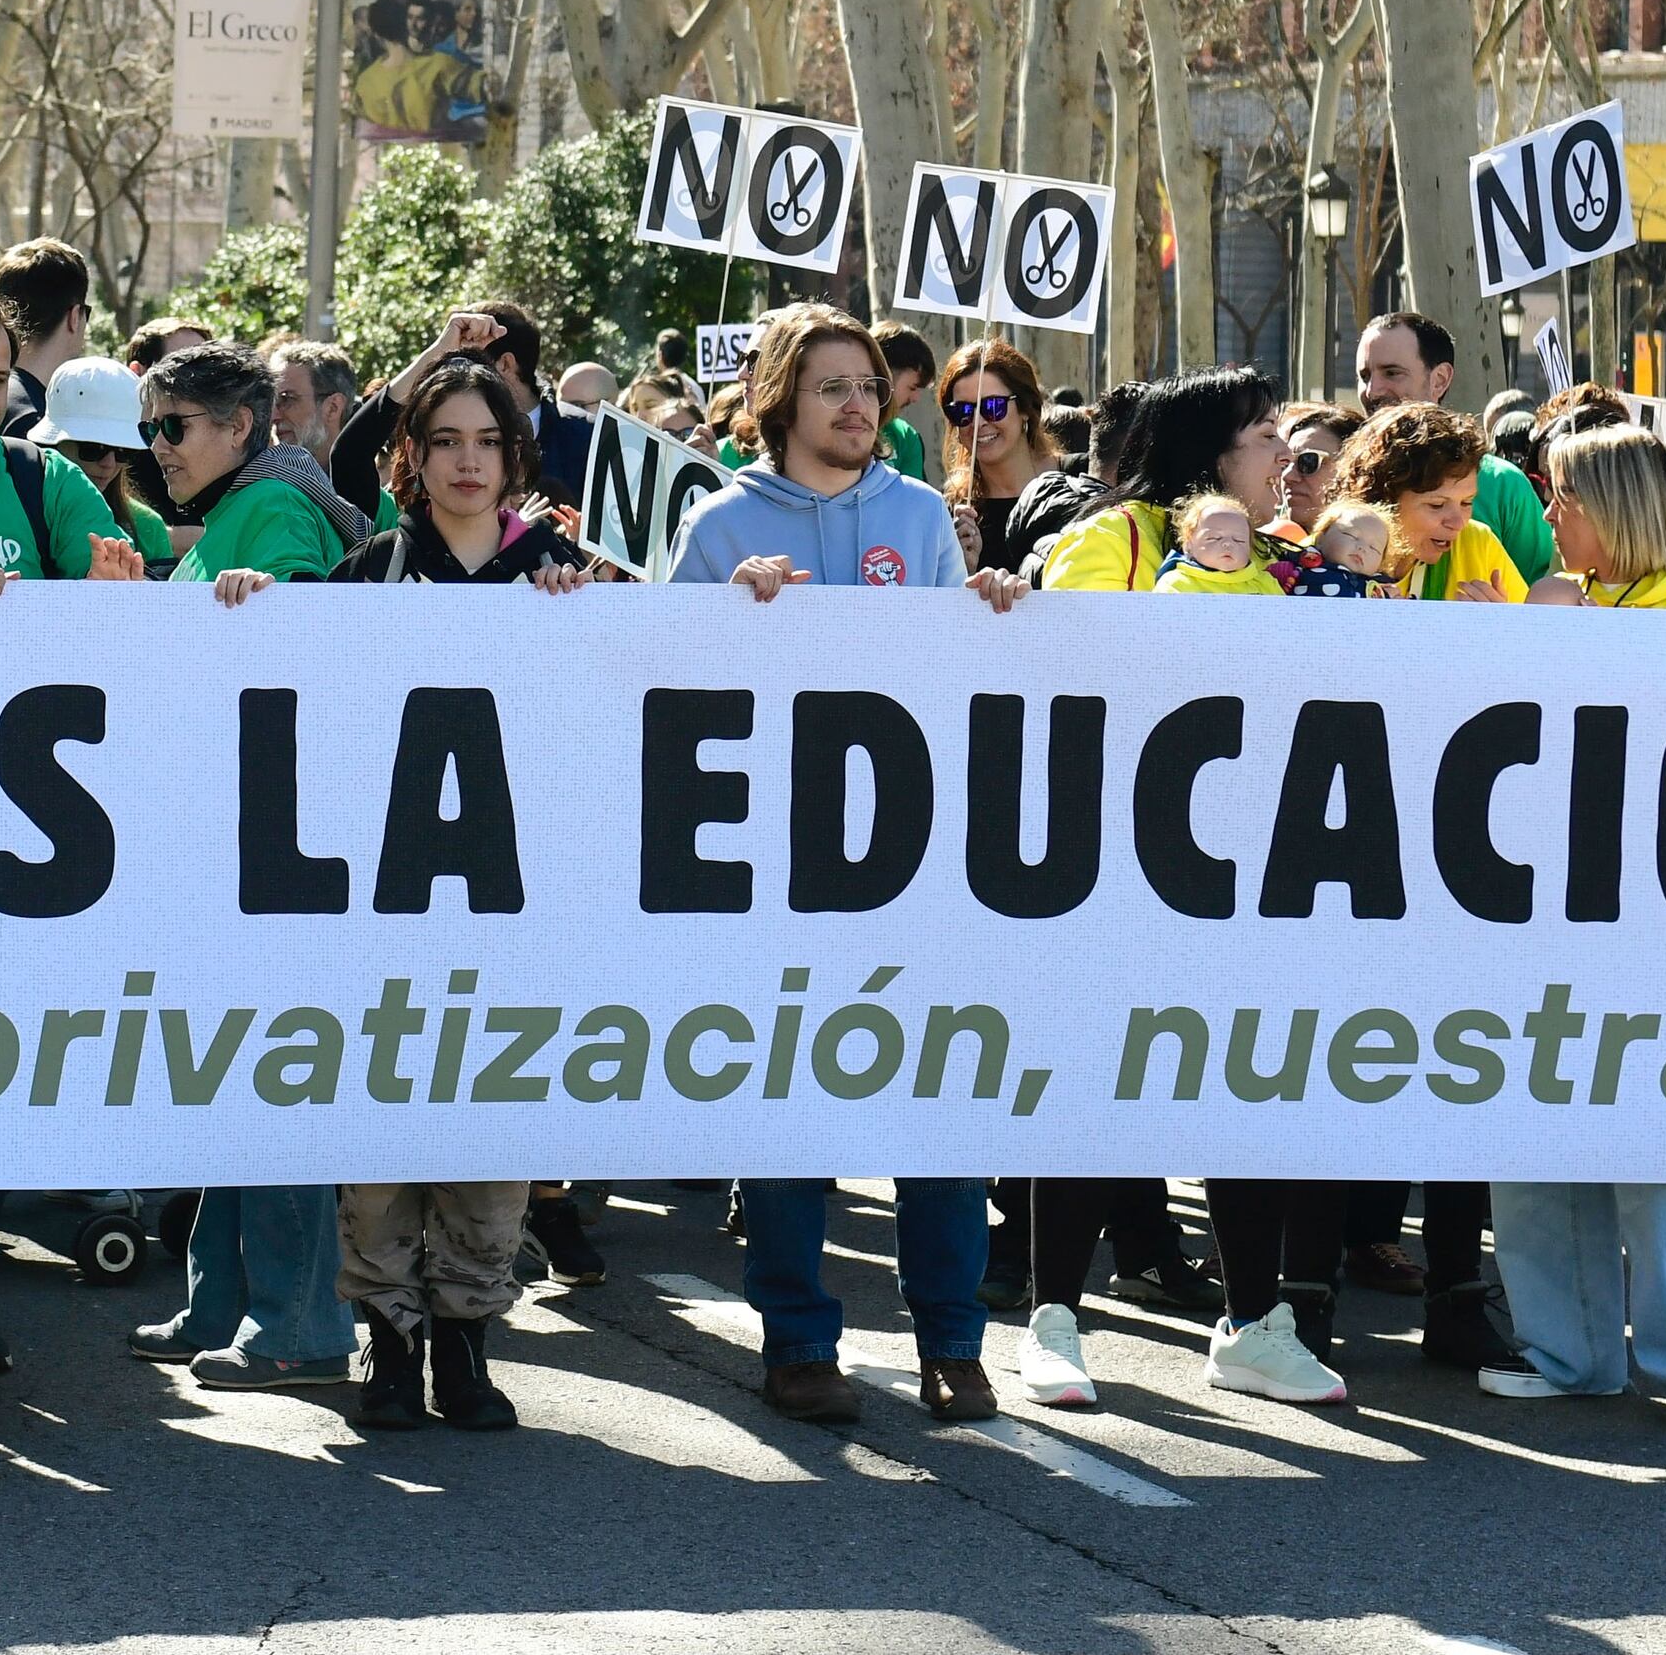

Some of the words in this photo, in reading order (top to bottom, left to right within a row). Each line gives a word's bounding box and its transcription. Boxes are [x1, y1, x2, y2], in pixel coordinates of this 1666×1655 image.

[188, 10, 212, 39] El
[221, 12, 298, 42] Greco
[646, 106, 844, 256] NO
[904, 173, 1099, 319] NO
[1476, 119, 1622, 285] NO
[239, 687, 524, 914] LA
